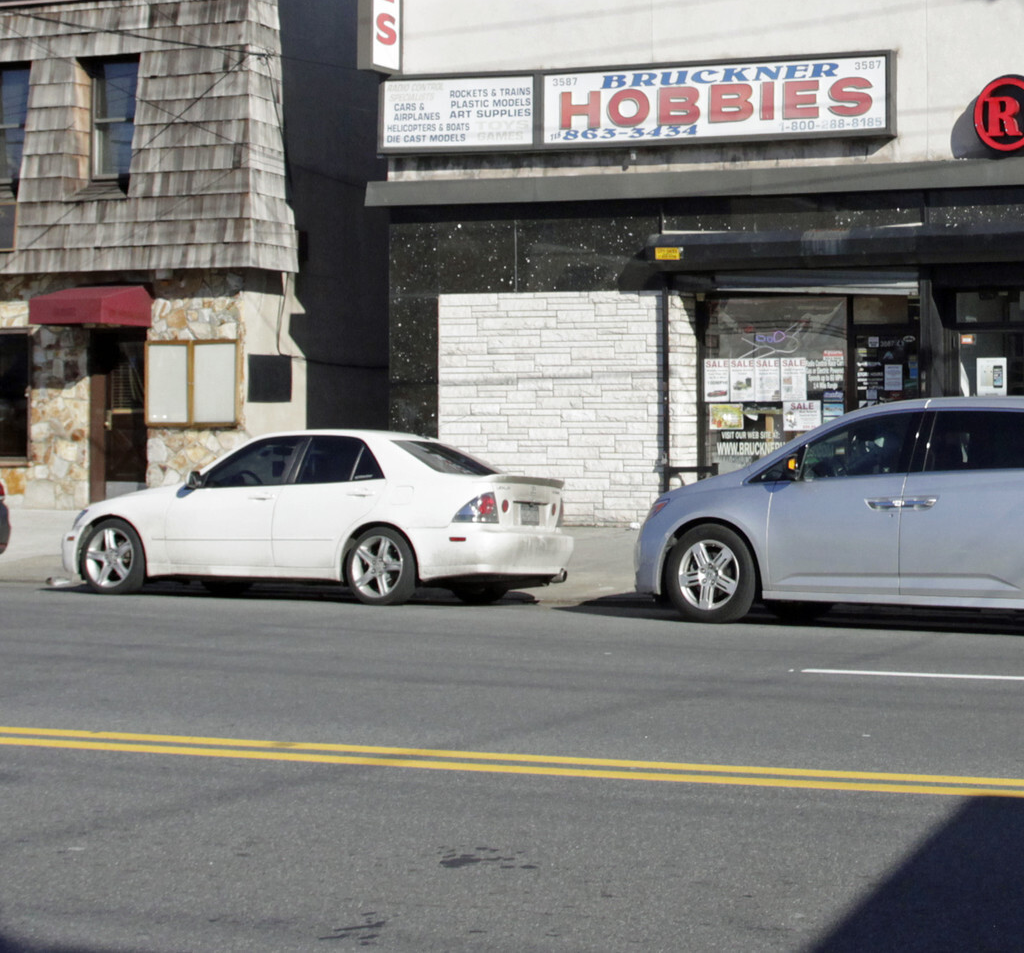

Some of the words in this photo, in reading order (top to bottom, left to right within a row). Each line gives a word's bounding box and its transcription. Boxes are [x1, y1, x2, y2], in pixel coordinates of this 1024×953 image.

[854, 60, 882, 71] 3587
[600, 62, 840, 89] BRUCKNER
[552, 77, 578, 87] 3587
[450, 89, 488, 98] ROCKETS
[491, 88, 497, 97] &
[500, 87, 531, 96] TRAINS
[394, 102, 416, 112] CARS
[419, 102, 425, 111] &
[450, 99, 489, 109] PLASTIC
[492, 98, 532, 107] MODELS
[559, 77, 874, 131] HOBBIES
[393, 112, 441, 121] AIRPLANES
[450, 110, 472, 119] ART
[476, 108, 532, 118] SUPPLIES
[387, 123, 437, 133] HELICOPTERS
[438, 123, 444, 132] &
[446, 122, 470, 131] BOATS
[475, 120, 529, 131] TOYS
[779, 117, 883, 132] 1-800-288-8185
[477, 131, 524, 141] GAMES
[563, 124, 698, 141] 863-3434
[386, 135, 401, 143] DIE
[403, 134, 427, 143] CAST
[429, 133, 466, 143] MODELS
[706, 360, 729, 368] SALE
[756, 359, 779, 367] SALE
[782, 359, 806, 367] SALE
[791, 402, 814, 410] SALE
[721, 431, 735, 439] VISIT
[735, 431, 747, 439] OUR
[747, 431, 759, 439] WEB
